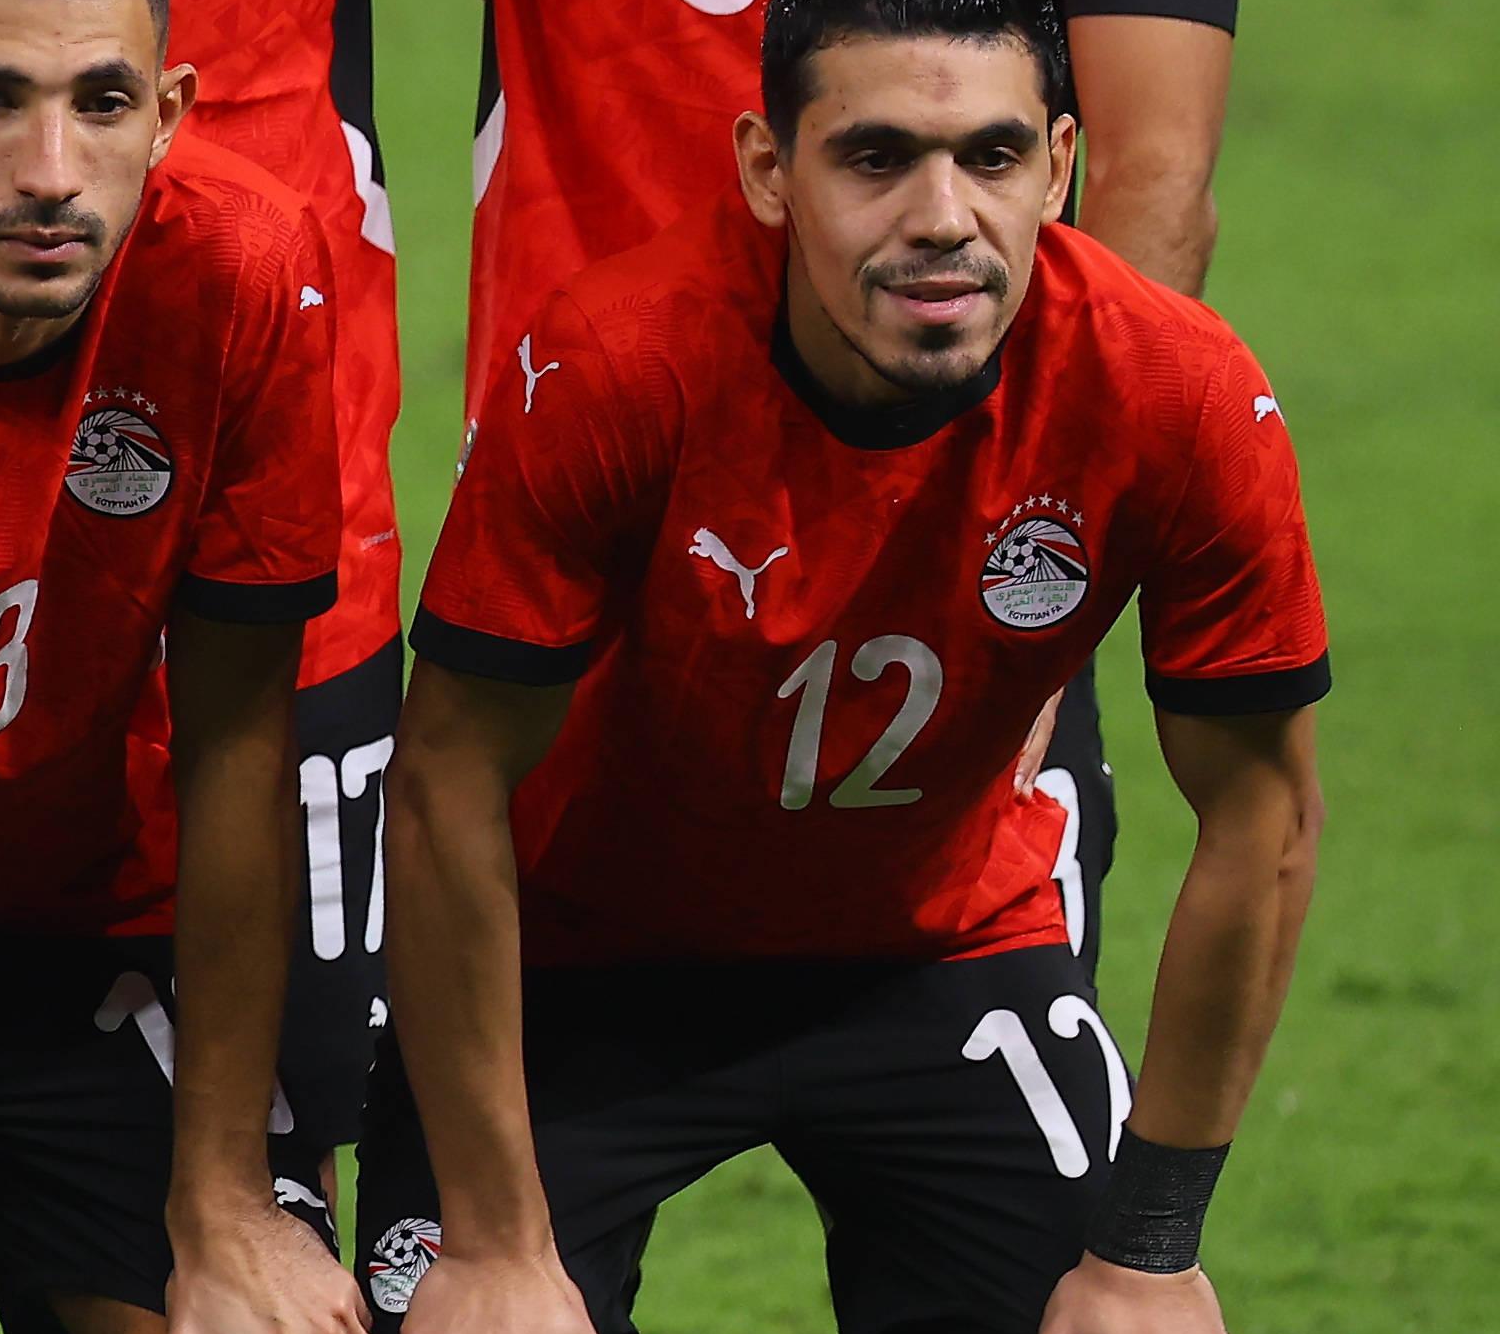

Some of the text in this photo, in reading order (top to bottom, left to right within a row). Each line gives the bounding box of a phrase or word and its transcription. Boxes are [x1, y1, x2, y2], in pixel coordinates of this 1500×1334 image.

[95, 494, 150, 508] EGYPTIAN FA
[1008, 604, 1063, 621] EGYPTIAN FA
[777, 633, 944, 811] 12
